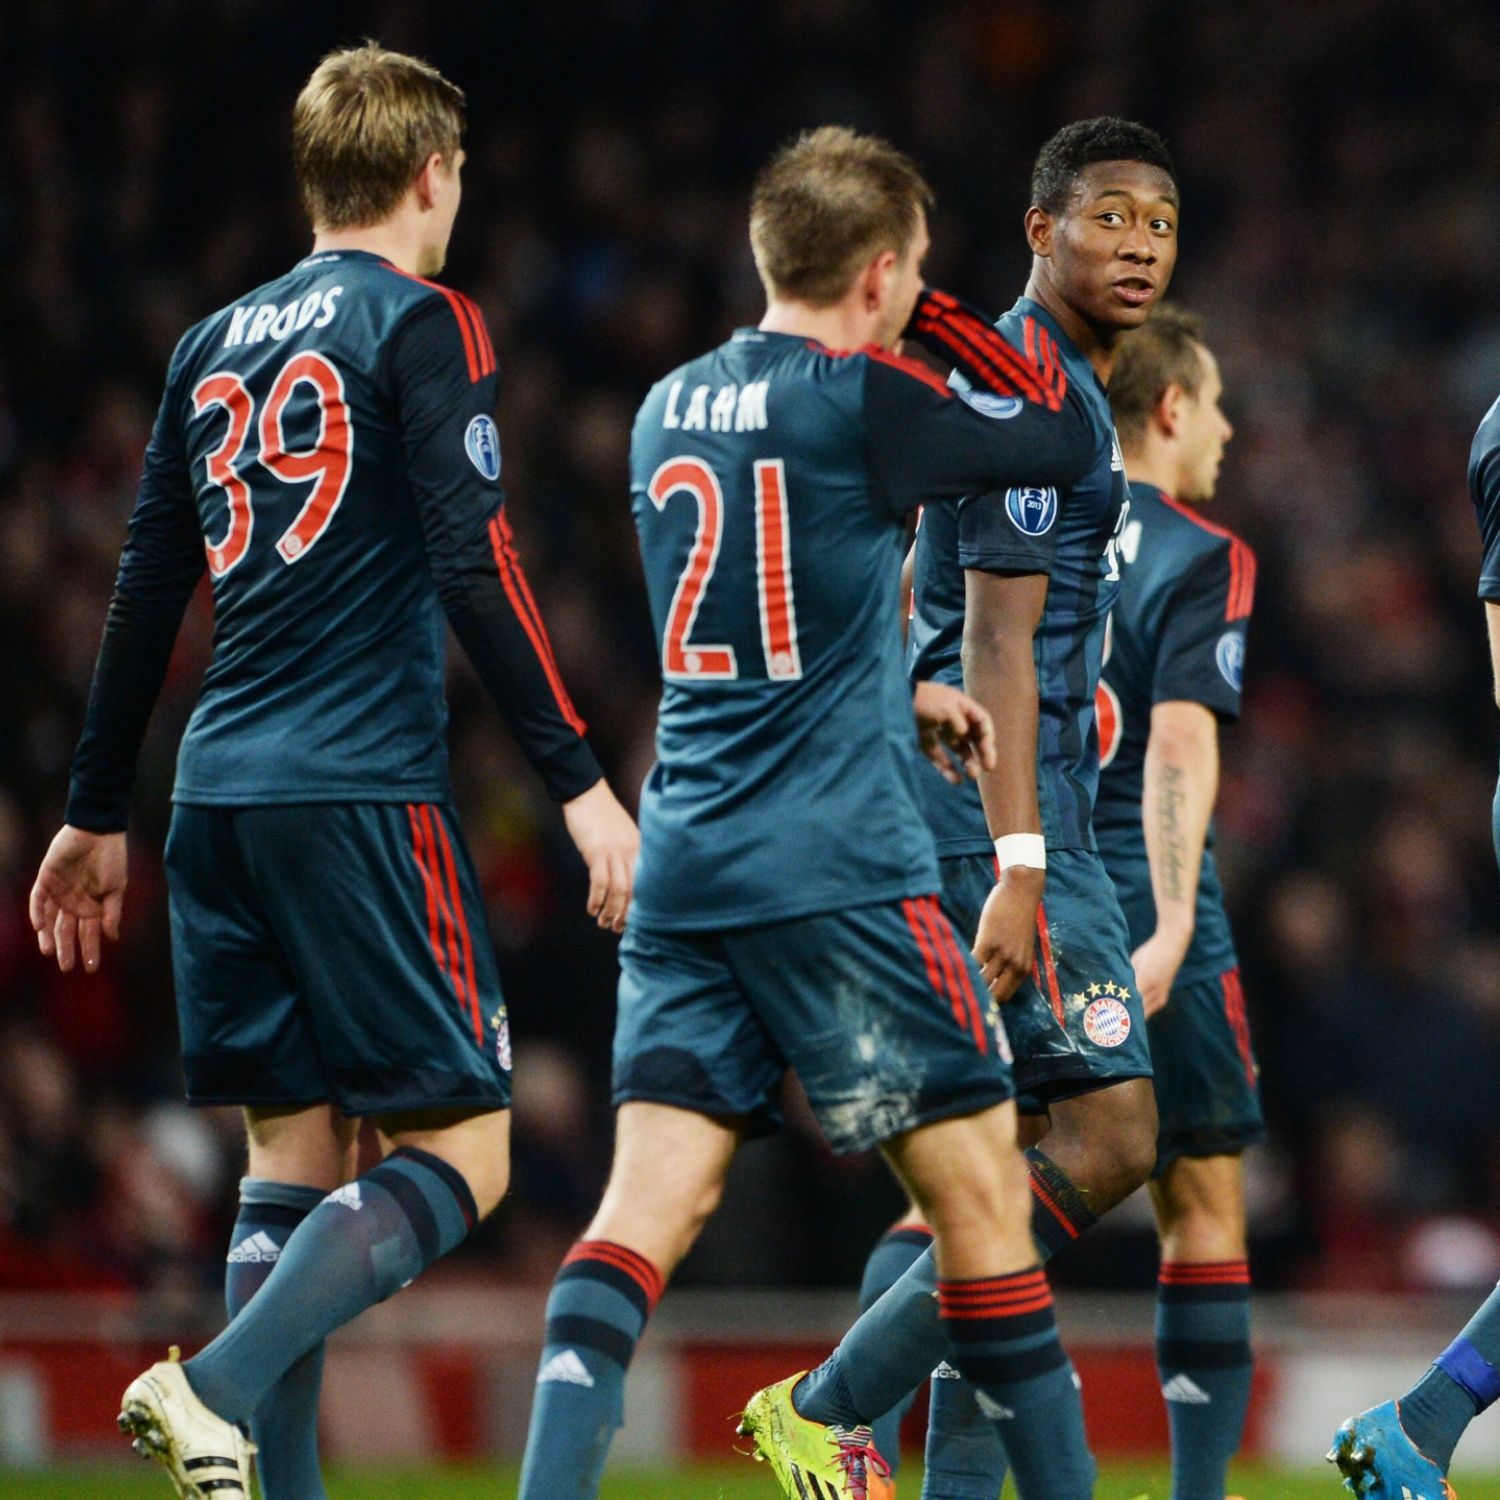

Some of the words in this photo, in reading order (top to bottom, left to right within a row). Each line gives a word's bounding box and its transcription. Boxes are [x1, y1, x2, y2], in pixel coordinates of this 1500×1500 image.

[192, 350, 354, 577] 39
[662, 380, 769, 433] LAHM
[647, 455, 803, 681] 21
